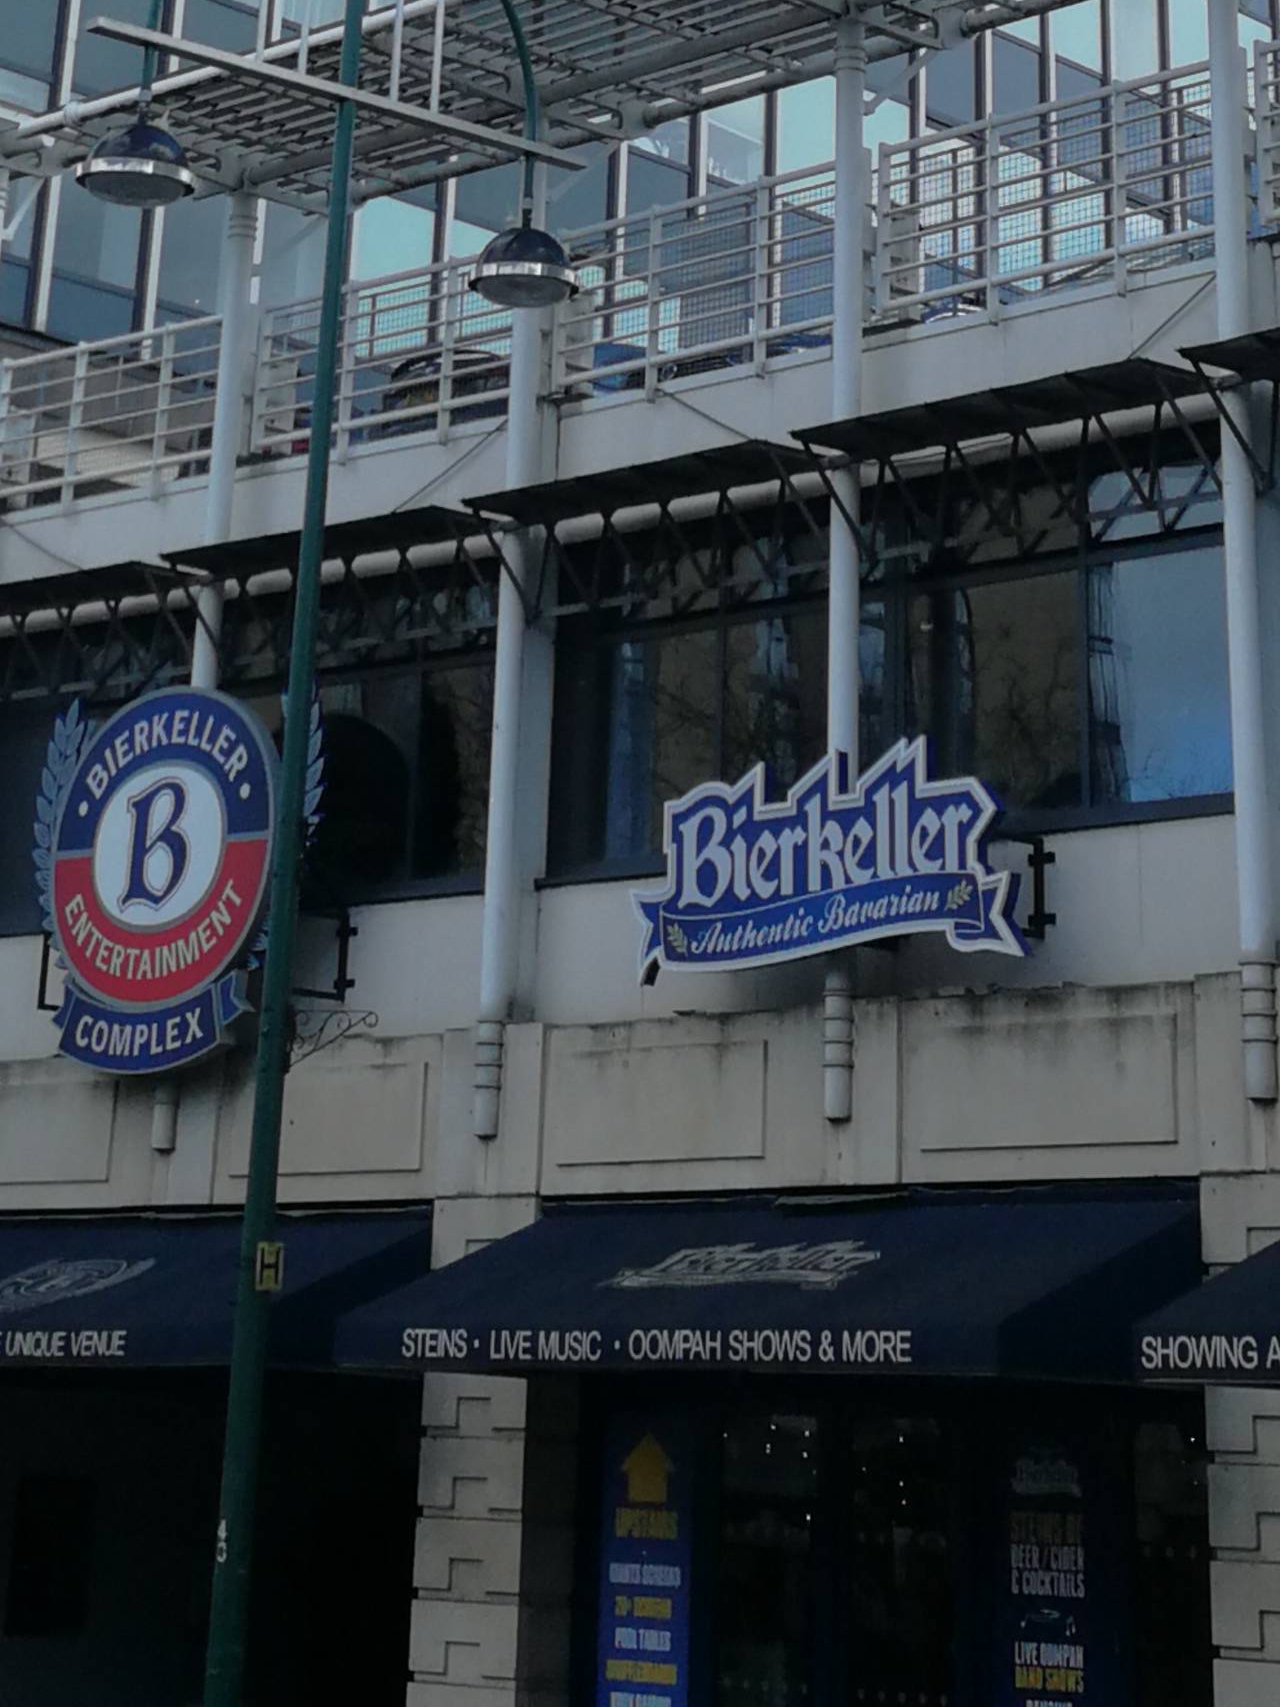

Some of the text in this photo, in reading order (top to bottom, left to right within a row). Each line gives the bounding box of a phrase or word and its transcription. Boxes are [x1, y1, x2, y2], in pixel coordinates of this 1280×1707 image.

[85, 709, 251, 801] BIERKELLER
[118, 776, 192, 914] B
[677, 780, 974, 910] Bierkeller
[63, 878, 244, 980] ENTERTAINMENT
[689, 884, 941, 956] Authentic Bavarian
[74, 1007, 205, 1058] COMPLEX
[259, 1247, 280, 1285] H
[5, 1329, 67, 1357] UNIQUE
[70, 1329, 127, 1357] VENUE
[401, 1327, 913, 1363] STEINS LIVE MUSIC OOMPAH SHOWS & MORE
[1140, 1334, 1259, 1371] SHOWING
[1021, 1569, 1086, 1599] COCKTAILS
